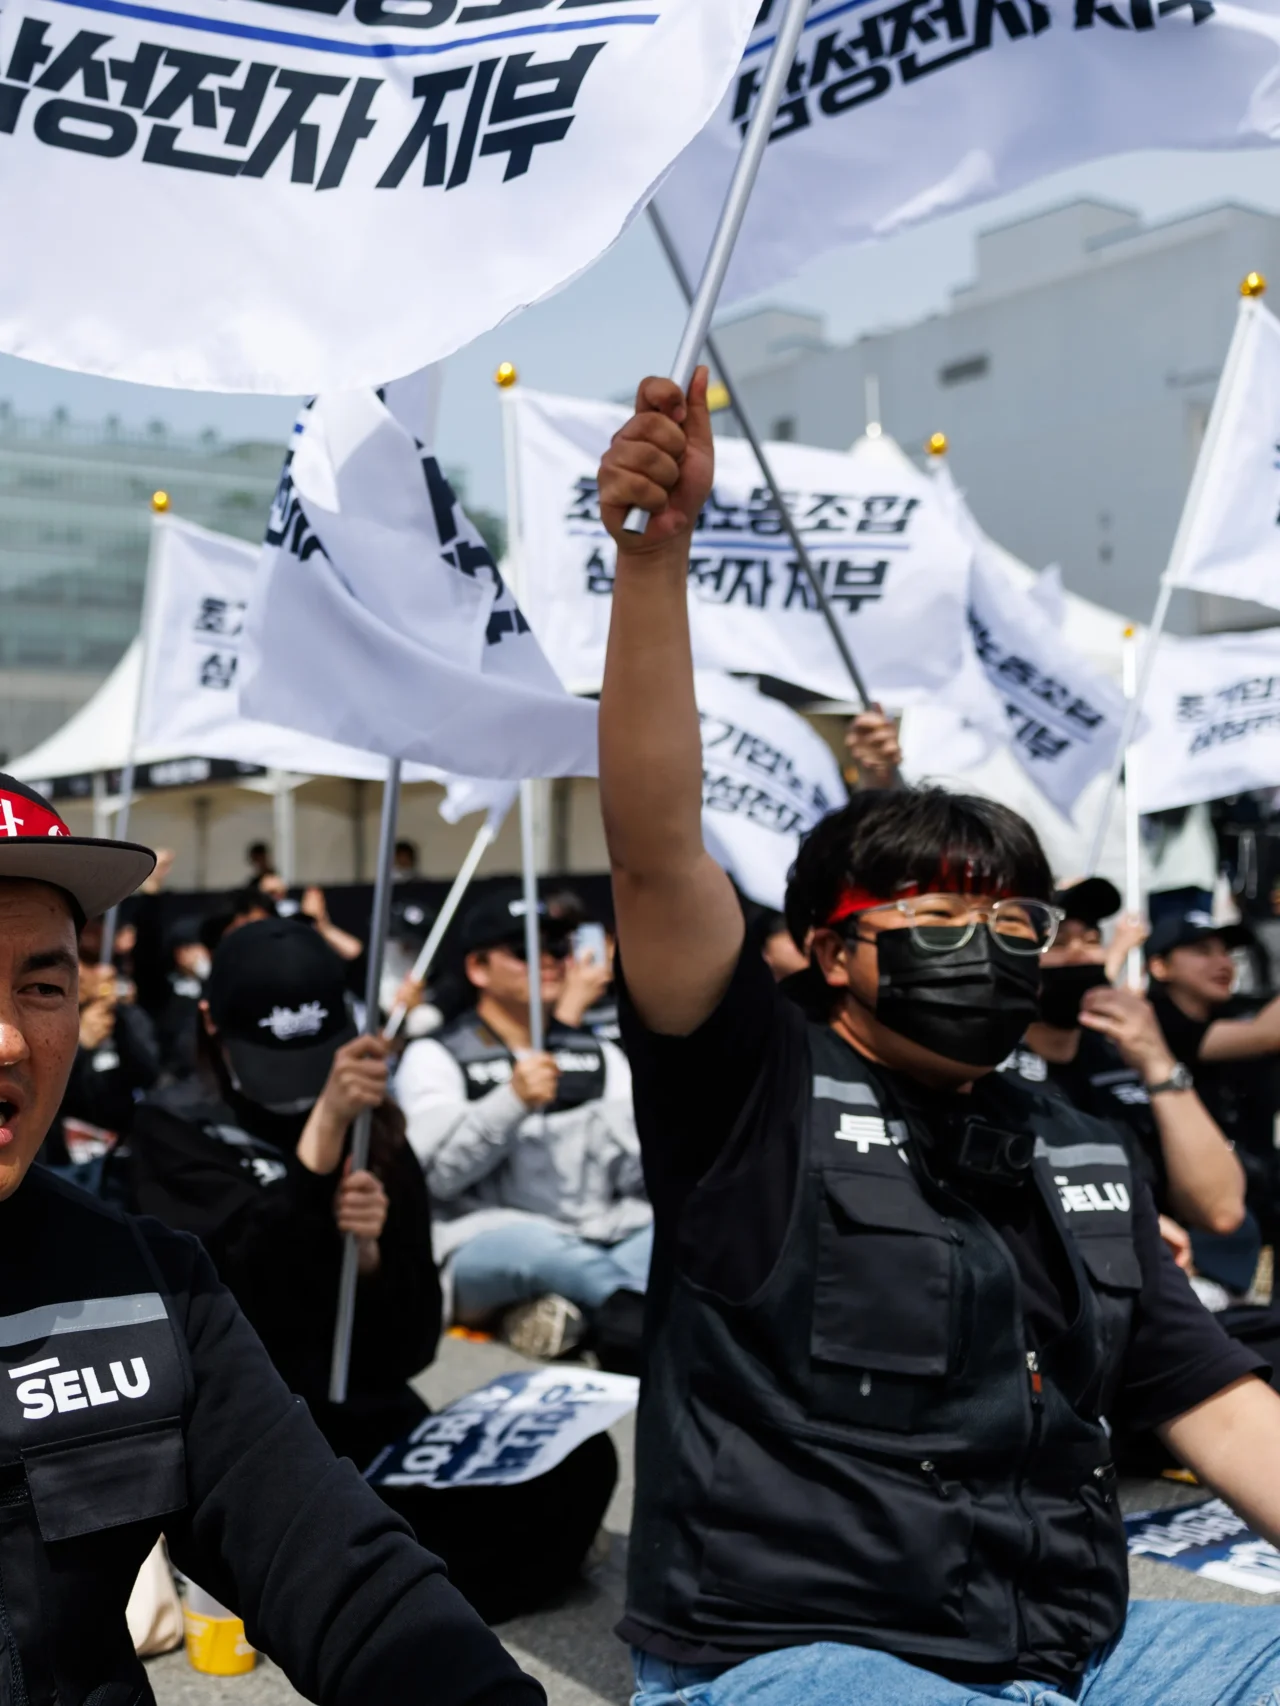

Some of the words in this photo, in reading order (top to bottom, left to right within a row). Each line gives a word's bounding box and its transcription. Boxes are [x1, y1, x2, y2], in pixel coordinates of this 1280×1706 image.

[374, 41, 608, 192] 지부
[568, 476, 921, 536] 초노동조합
[585, 548, 774, 609] 삼전자
[834, 1113, 910, 1166] 투
[8, 1356, 151, 1421] SELU
